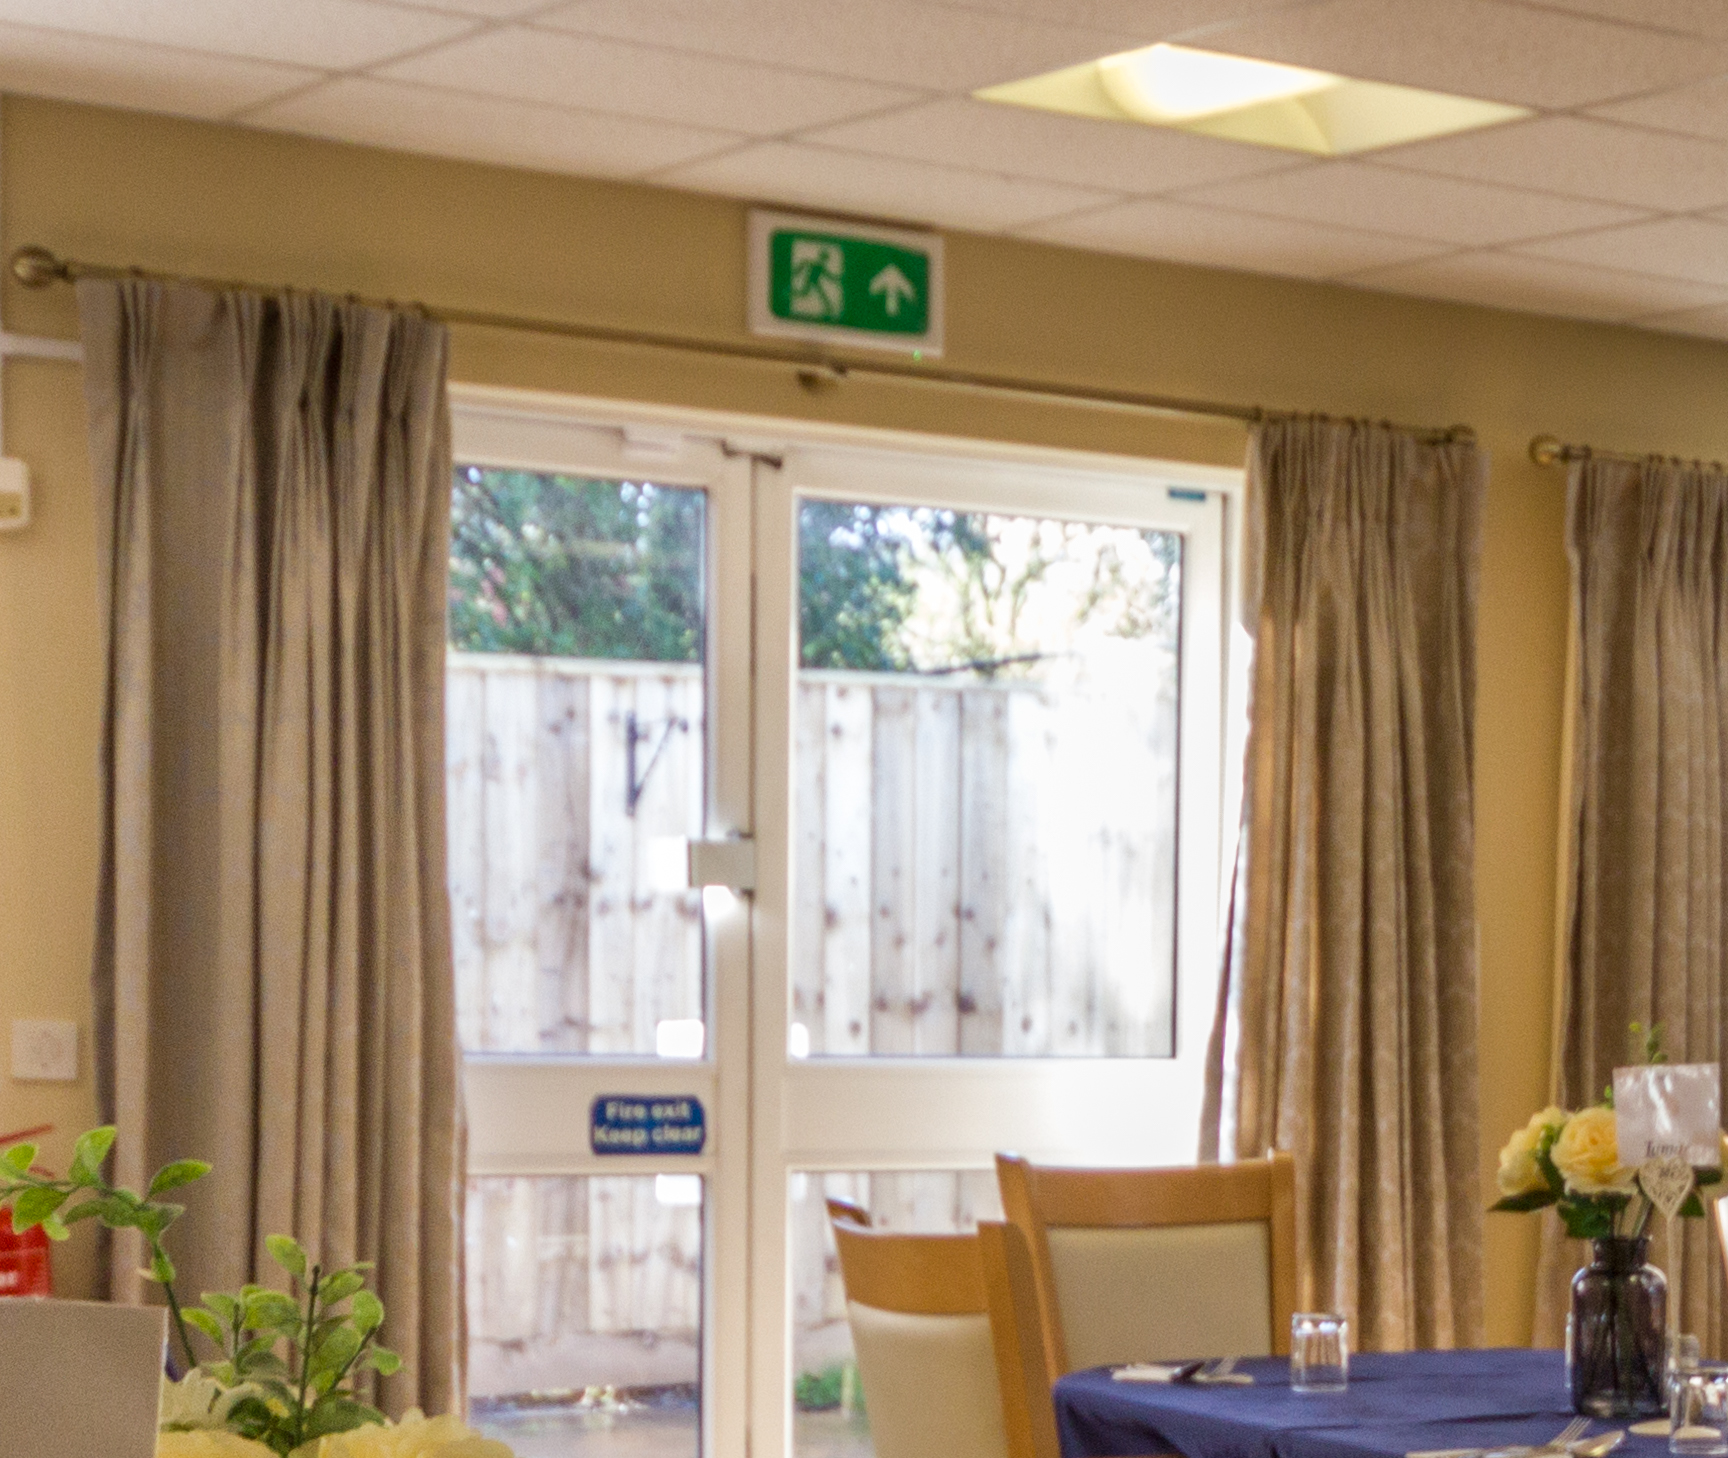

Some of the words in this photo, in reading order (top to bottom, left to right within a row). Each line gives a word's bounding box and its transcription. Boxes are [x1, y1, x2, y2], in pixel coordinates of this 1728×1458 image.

[605, 1101, 647, 1120] Fire
[651, 1101, 691, 1120] exit
[594, 1125, 648, 1147] Keep
[651, 1125, 702, 1144] clear
